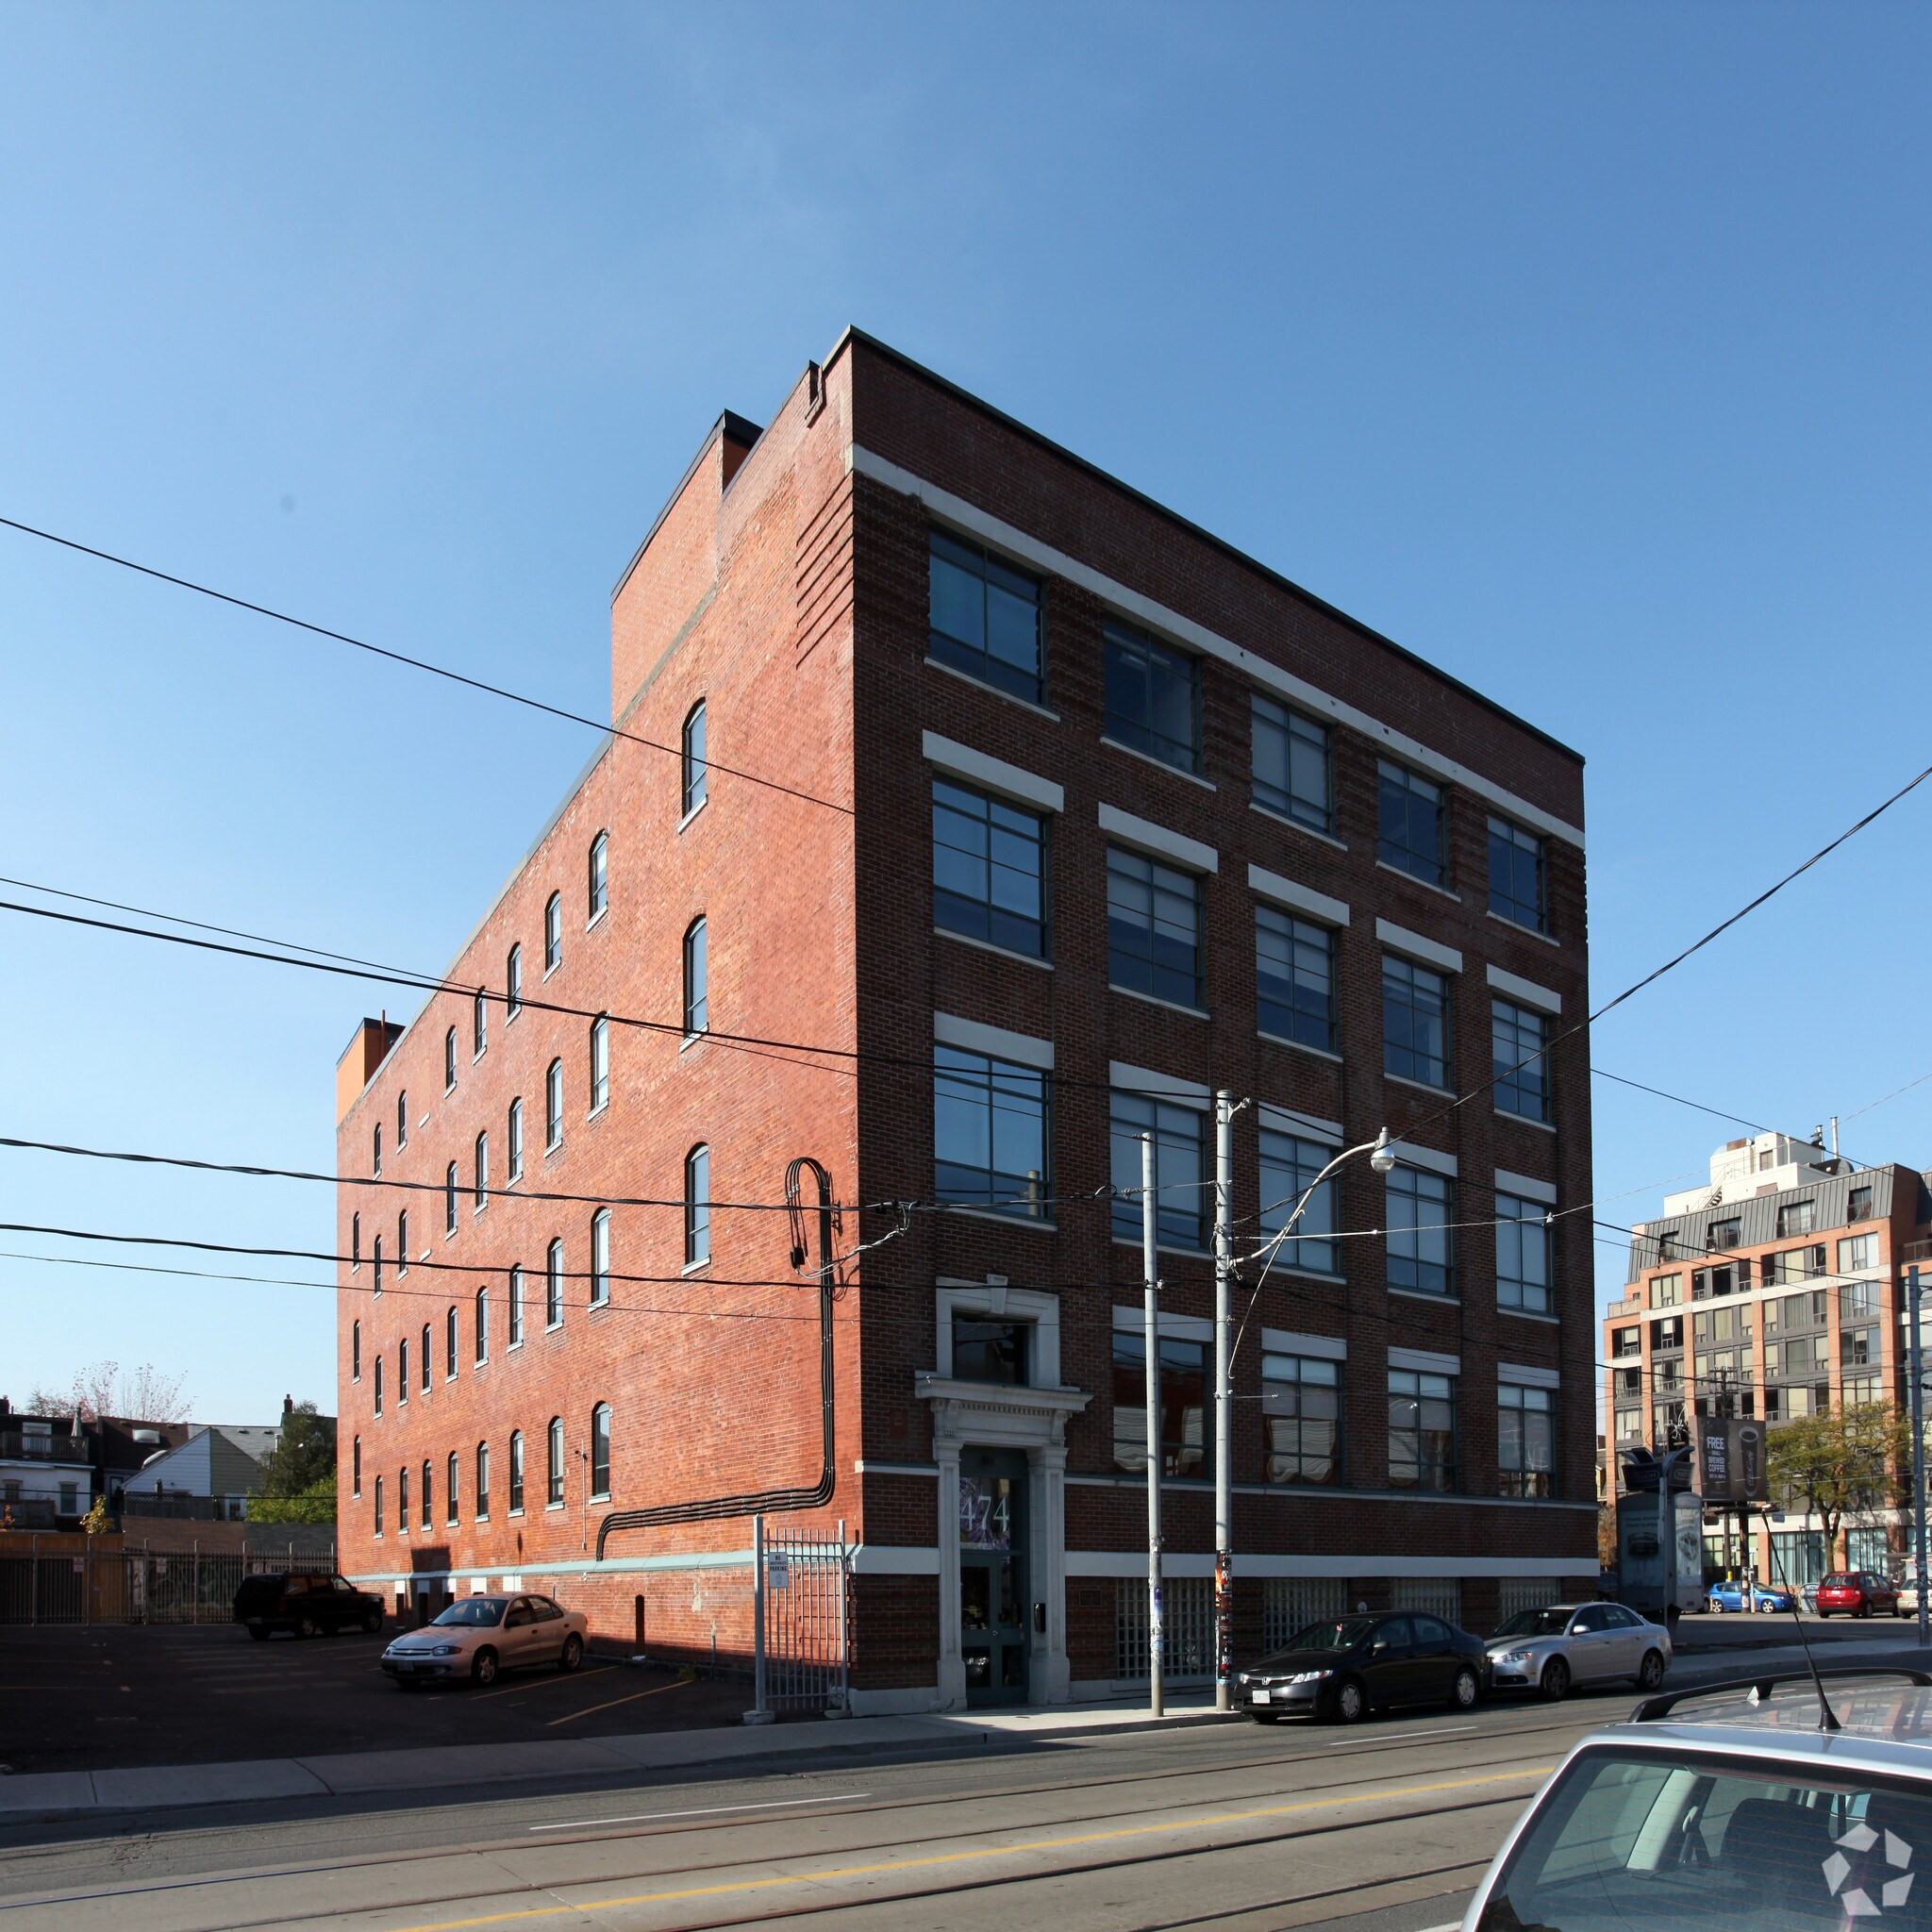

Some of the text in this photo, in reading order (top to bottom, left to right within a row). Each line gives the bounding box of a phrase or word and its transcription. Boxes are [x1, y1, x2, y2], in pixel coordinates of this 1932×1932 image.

[1707, 1437, 1724, 1450] FREE
[1708, 1464, 1725, 1473] COFFEE
[960, 1495, 1009, 1532] 474
